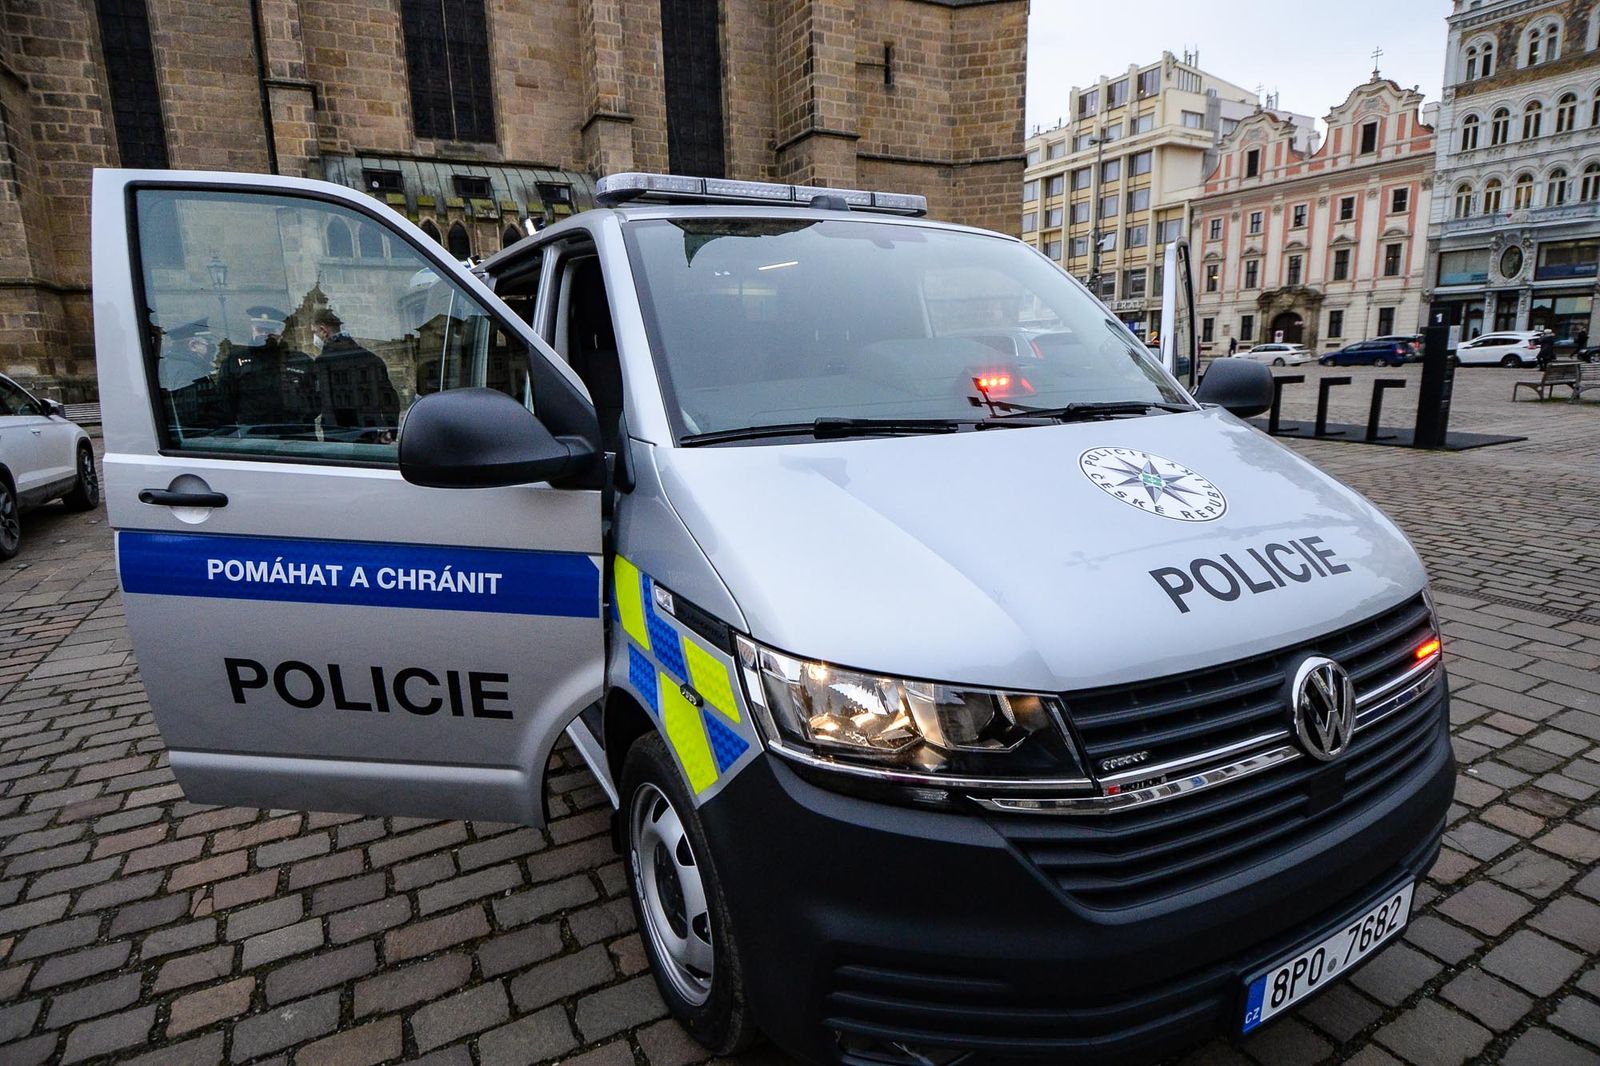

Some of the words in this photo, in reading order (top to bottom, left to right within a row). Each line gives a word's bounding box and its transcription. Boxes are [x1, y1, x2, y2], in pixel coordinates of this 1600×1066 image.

[1084, 448, 1148, 468] POLICIE
[1091, 472, 1166, 515] ČESKÉ
[1165, 461, 1220, 520] REPUBLIKY
[207, 556, 342, 588] POMÁHAT
[349, 566, 370, 588] A
[377, 565, 503, 595] CHRÁNIT
[1148, 536, 1351, 614] POLICIE
[223, 657, 514, 720] POLICIE
[1270, 947, 1326, 1009] 8P0
[1343, 895, 1402, 966] 7682
[1244, 1006, 1261, 1024] CZ
